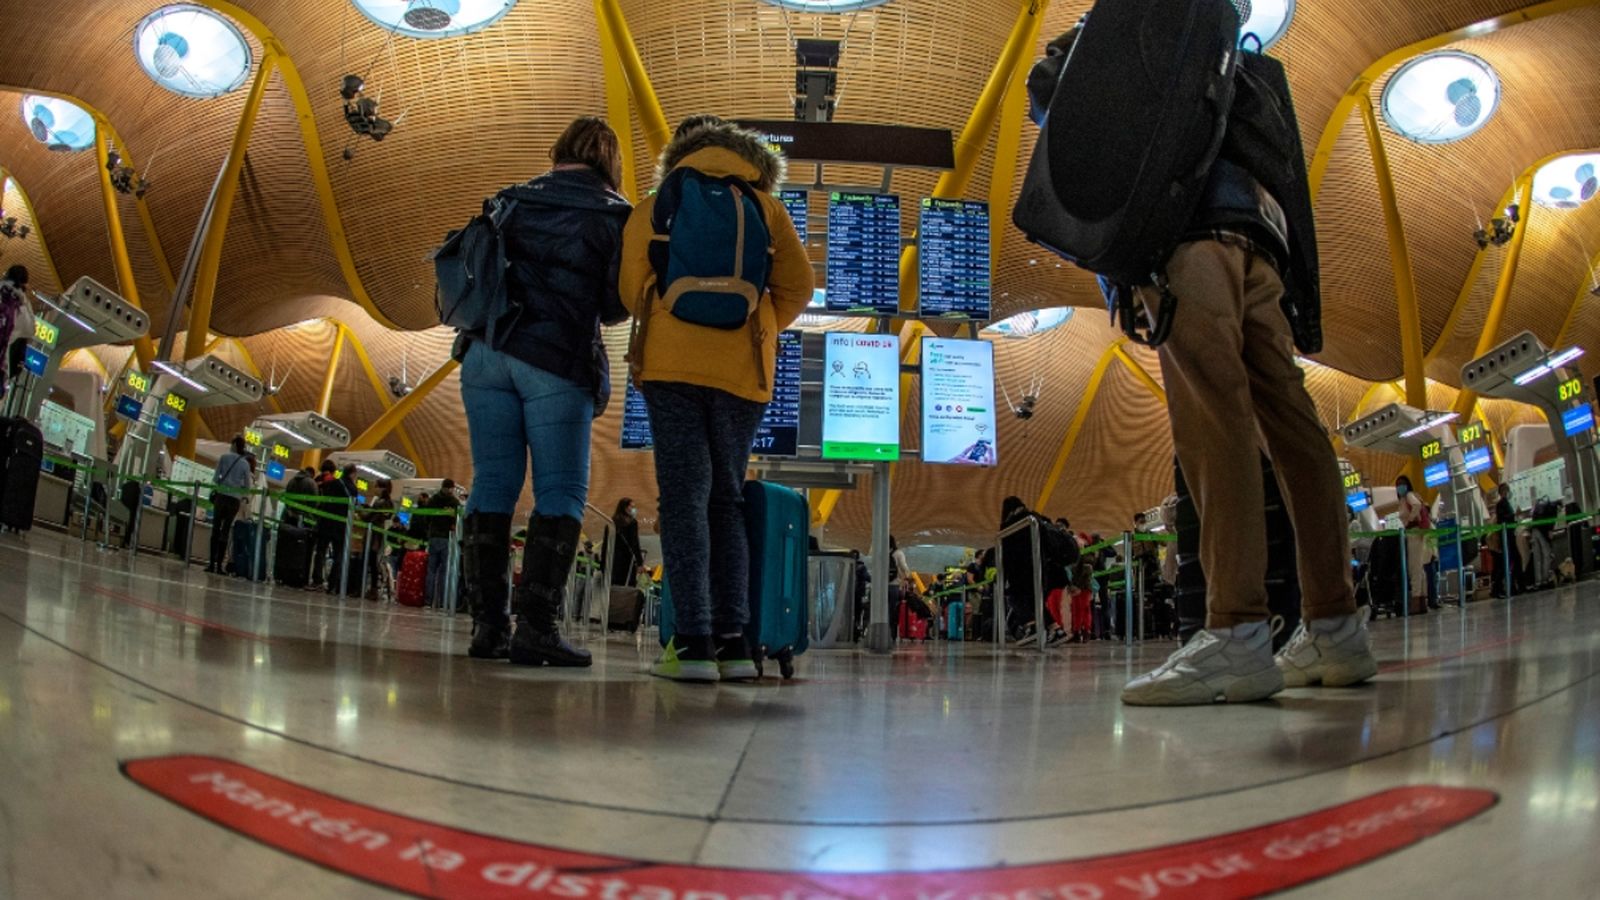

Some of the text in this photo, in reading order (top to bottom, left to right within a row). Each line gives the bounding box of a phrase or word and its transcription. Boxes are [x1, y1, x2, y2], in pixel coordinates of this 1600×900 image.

[128, 372, 146, 393] 881
[1559, 379, 1581, 400] 870
[167, 392, 186, 412] 882
[1462, 425, 1480, 443] 871
[1422, 441, 1440, 459] 872
[188, 771, 391, 850] Mantén
[398, 838, 466, 871] la
[1114, 852, 1255, 898] your
[1262, 796, 1447, 860] distance
